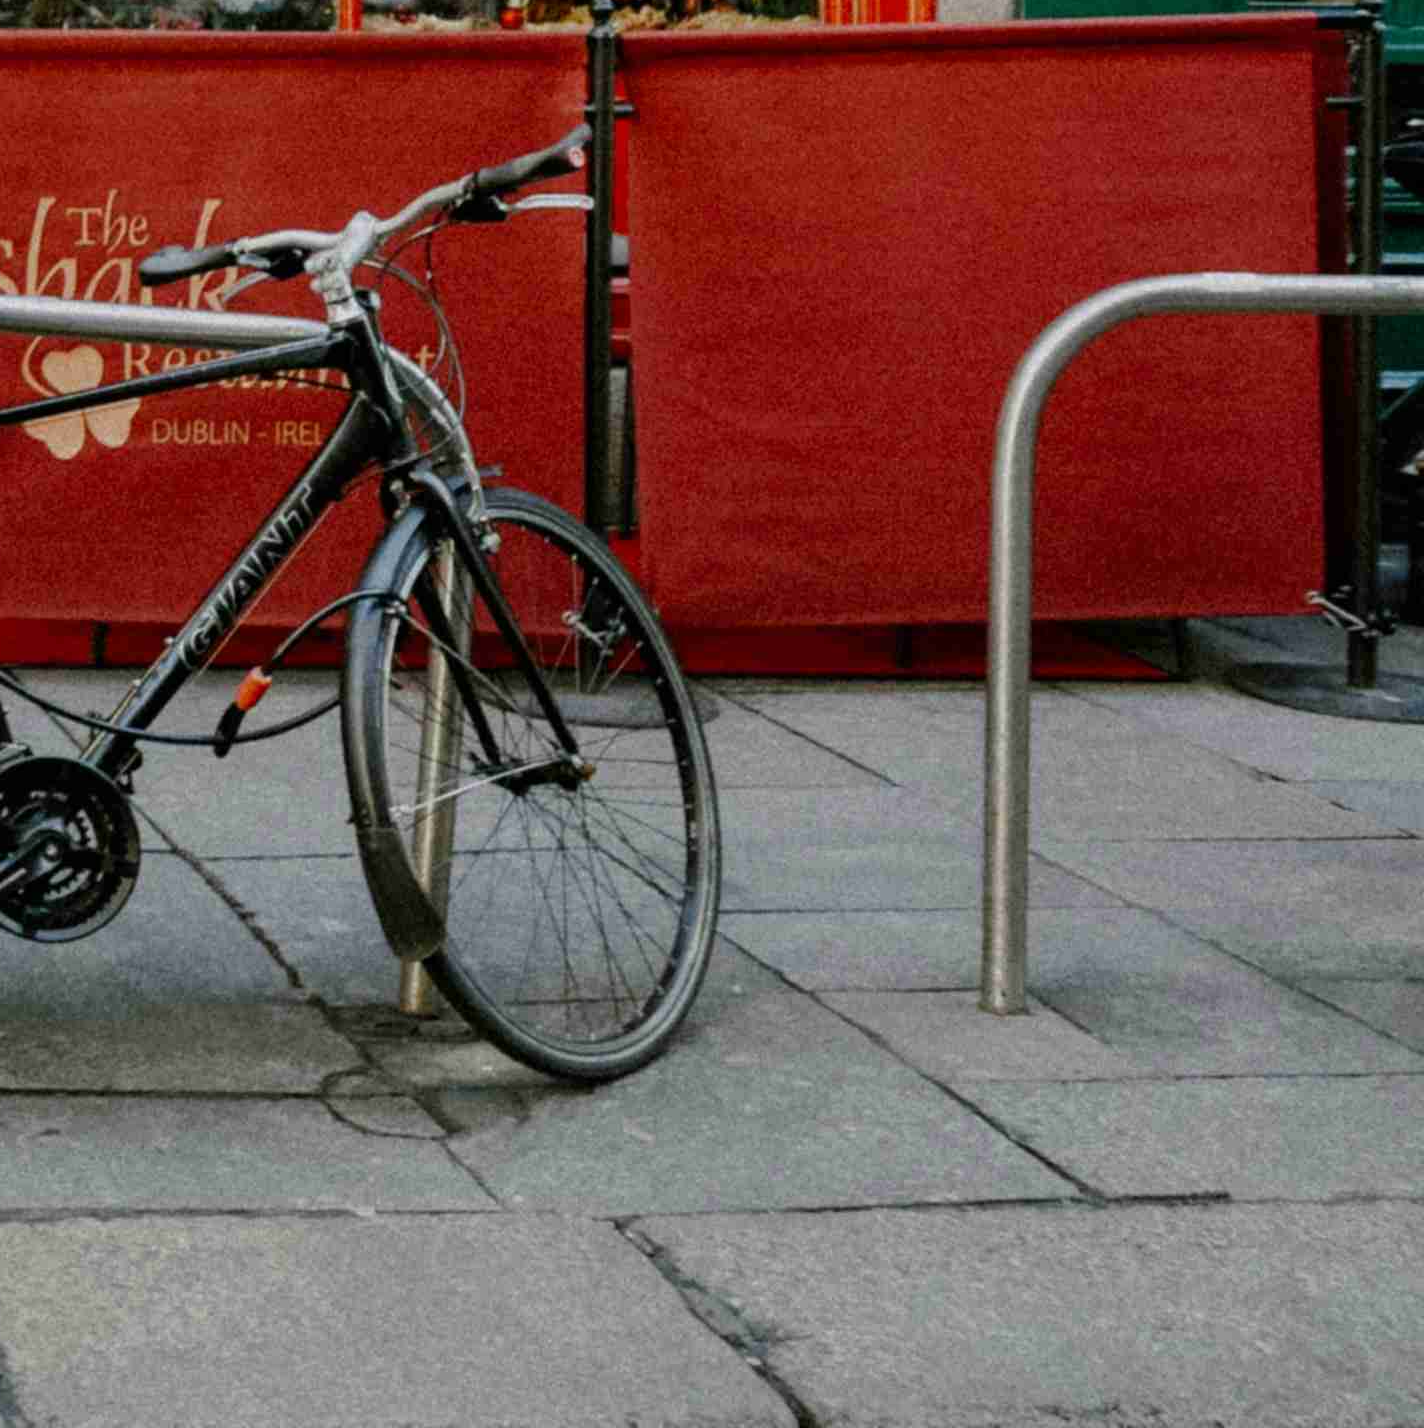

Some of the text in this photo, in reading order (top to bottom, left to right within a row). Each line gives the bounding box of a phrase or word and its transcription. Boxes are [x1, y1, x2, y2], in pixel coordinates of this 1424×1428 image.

[64, 187, 150, 254] The
[151, 419, 251, 445] DUBLIN
[274, 419, 324, 445] IREL
[175, 480, 315, 670] GIANT
